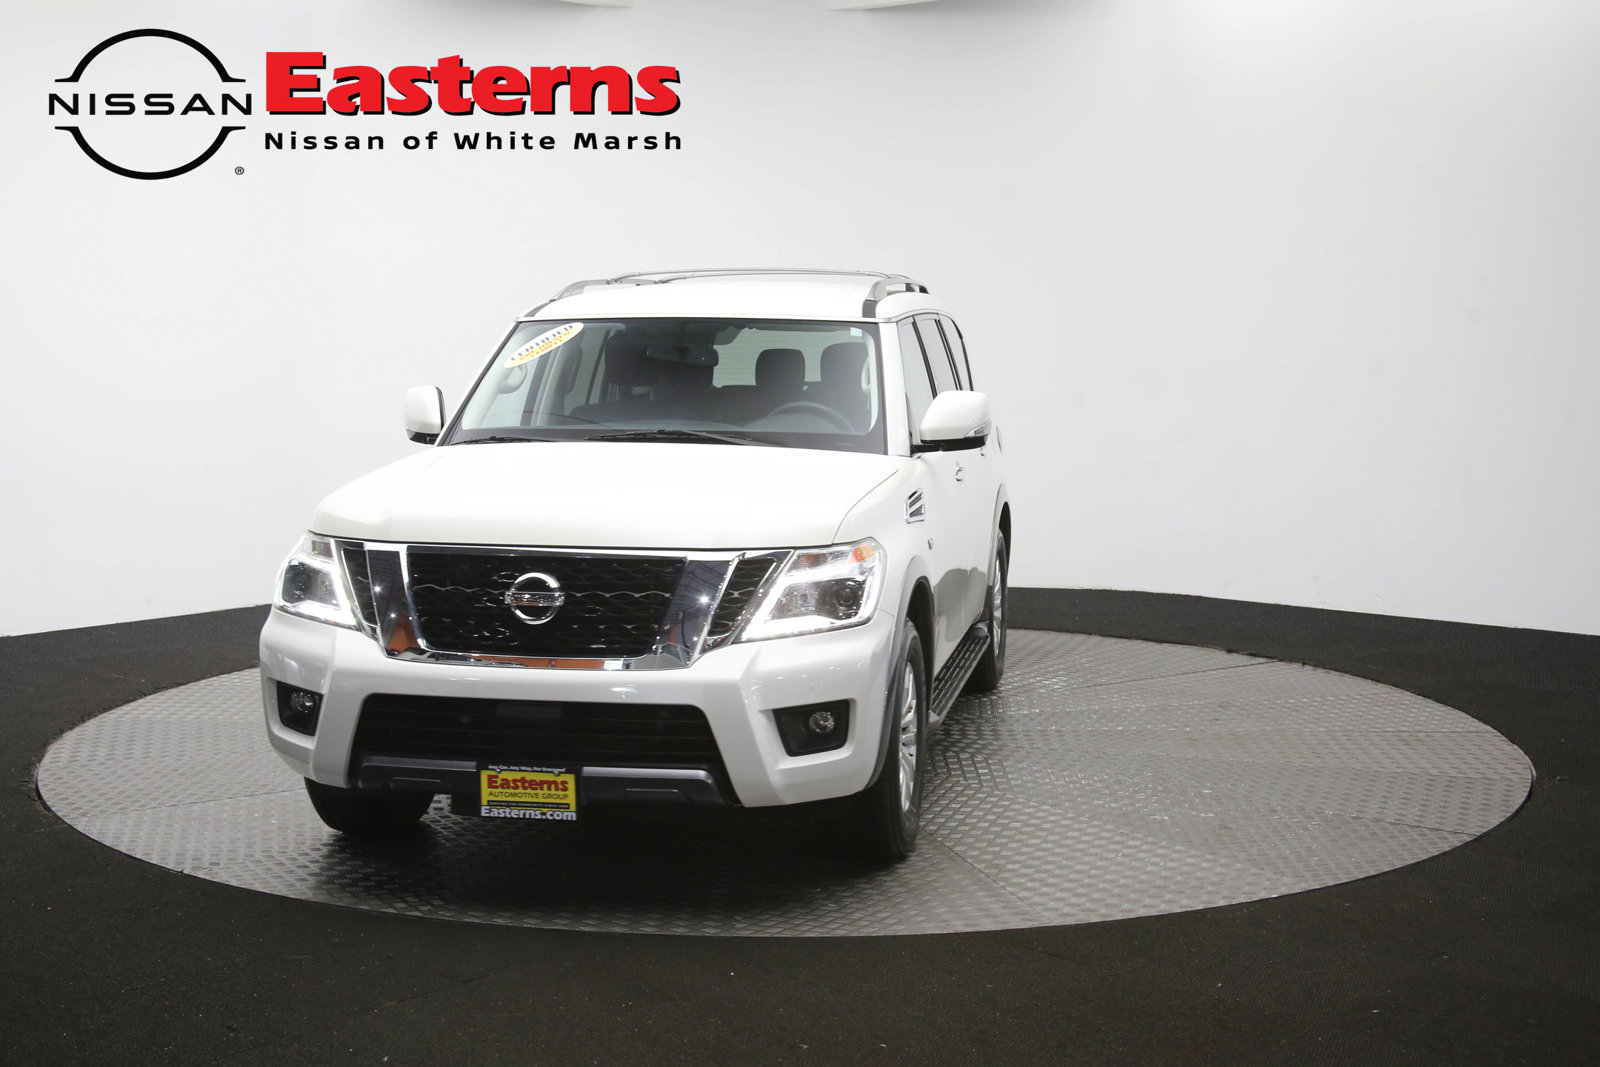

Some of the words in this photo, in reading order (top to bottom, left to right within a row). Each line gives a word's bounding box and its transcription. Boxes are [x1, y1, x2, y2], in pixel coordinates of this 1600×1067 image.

[487, 775, 568, 791] Easterns
[488, 791, 540, 799] AUTOMOTIVE
[541, 792, 569, 800] GROUP
[481, 805, 576, 820] Easterns.com
